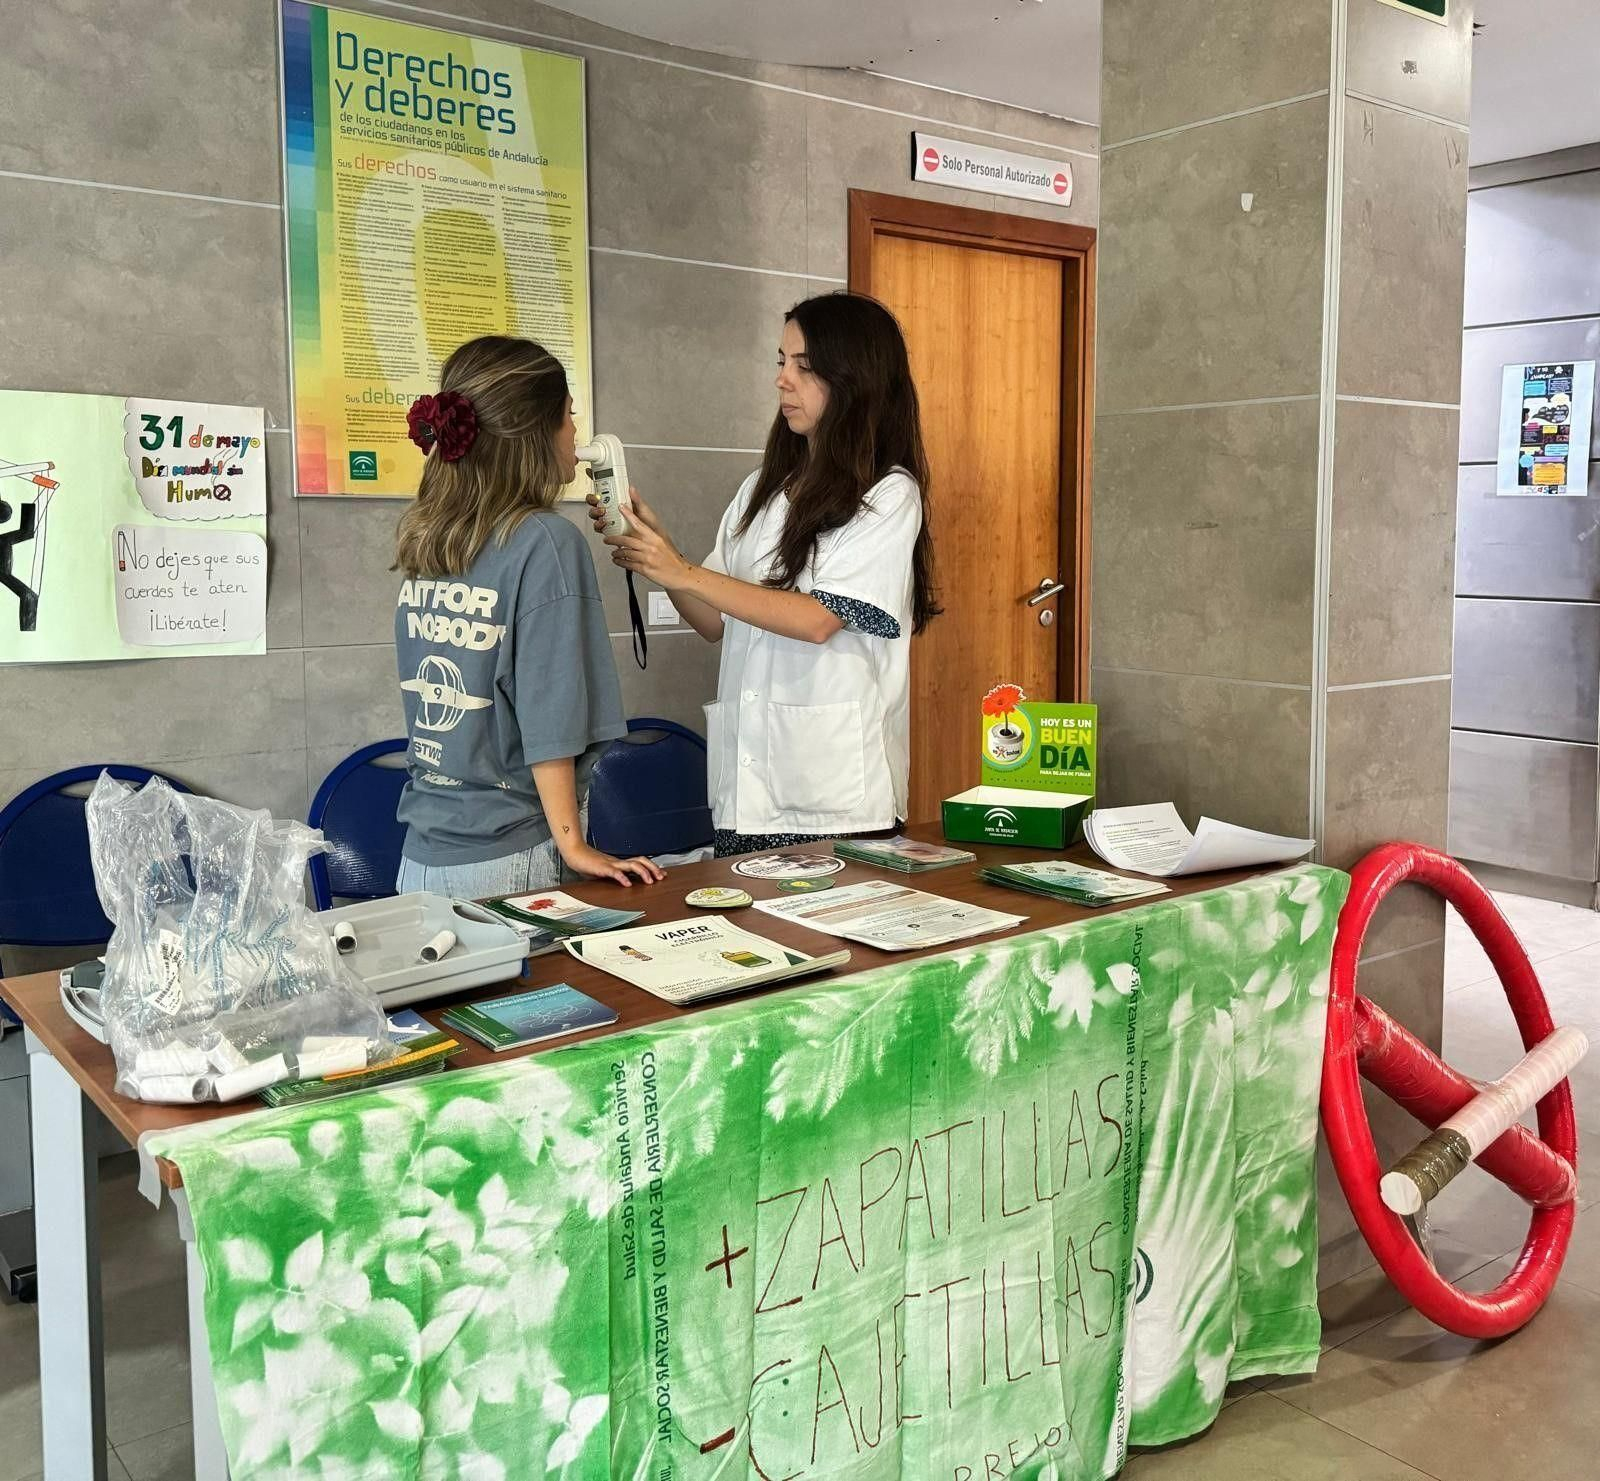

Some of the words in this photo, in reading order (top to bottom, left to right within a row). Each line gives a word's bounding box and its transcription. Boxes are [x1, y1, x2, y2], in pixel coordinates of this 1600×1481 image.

[336, 30, 513, 99] Derechos
[335, 78, 354, 109] y
[365, 76, 516, 135] deberes
[340, 112, 353, 123] de
[356, 114, 372, 127] los
[374, 116, 432, 136] ciudadanos
[435, 127, 448, 138] en
[451, 128, 465, 141] los
[340, 125, 388, 141] servicios
[390, 132, 442, 149] sanitarios
[444, 141, 486, 159] públicos
[488, 147, 500, 159] de
[502, 150, 549, 166] Andalucía
[337, 158, 352, 169] Sus
[354, 152, 437, 180] derechos
[438, 176, 458, 185] como
[459, 177, 487, 189] usuario
[488, 182, 499, 190] en
[499, 180, 506, 191] el
[506, 183, 535, 197] sistema
[535, 186, 568, 199] sanitario
[942, 154, 962, 172] Solo
[965, 159, 1003, 178] Personal
[1005, 167, 1051, 187] Autorizado
[345, 394, 360, 403] Sus
[139, 413, 183, 451] 31
[189, 424, 215, 448] de
[216, 435, 261, 459] mayo
[141, 456, 168, 478] Día
[172, 457, 224, 477] mundial
[117, 529, 149, 571] No
[156, 546, 200, 580] dejes
[204, 555, 229, 580] que
[236, 555, 260, 565] sus
[182, 580, 199, 597] te
[209, 580, 248, 594] aten
[432, 580, 498, 618] FOR
[150, 609, 226, 632] ¡Libérate!
[433, 687, 442, 700] 9
[1040, 718, 1060, 727] HOY
[1063, 719, 1075, 728] ES
[1077, 719, 1091, 728] UN
[1040, 728, 1092, 745] BUEN
[654, 925, 713, 941] VAPER
[755, 1074, 1123, 1314] ZAPATILLAS
[747, 1221, 1115, 1481] CAJETILLAS
